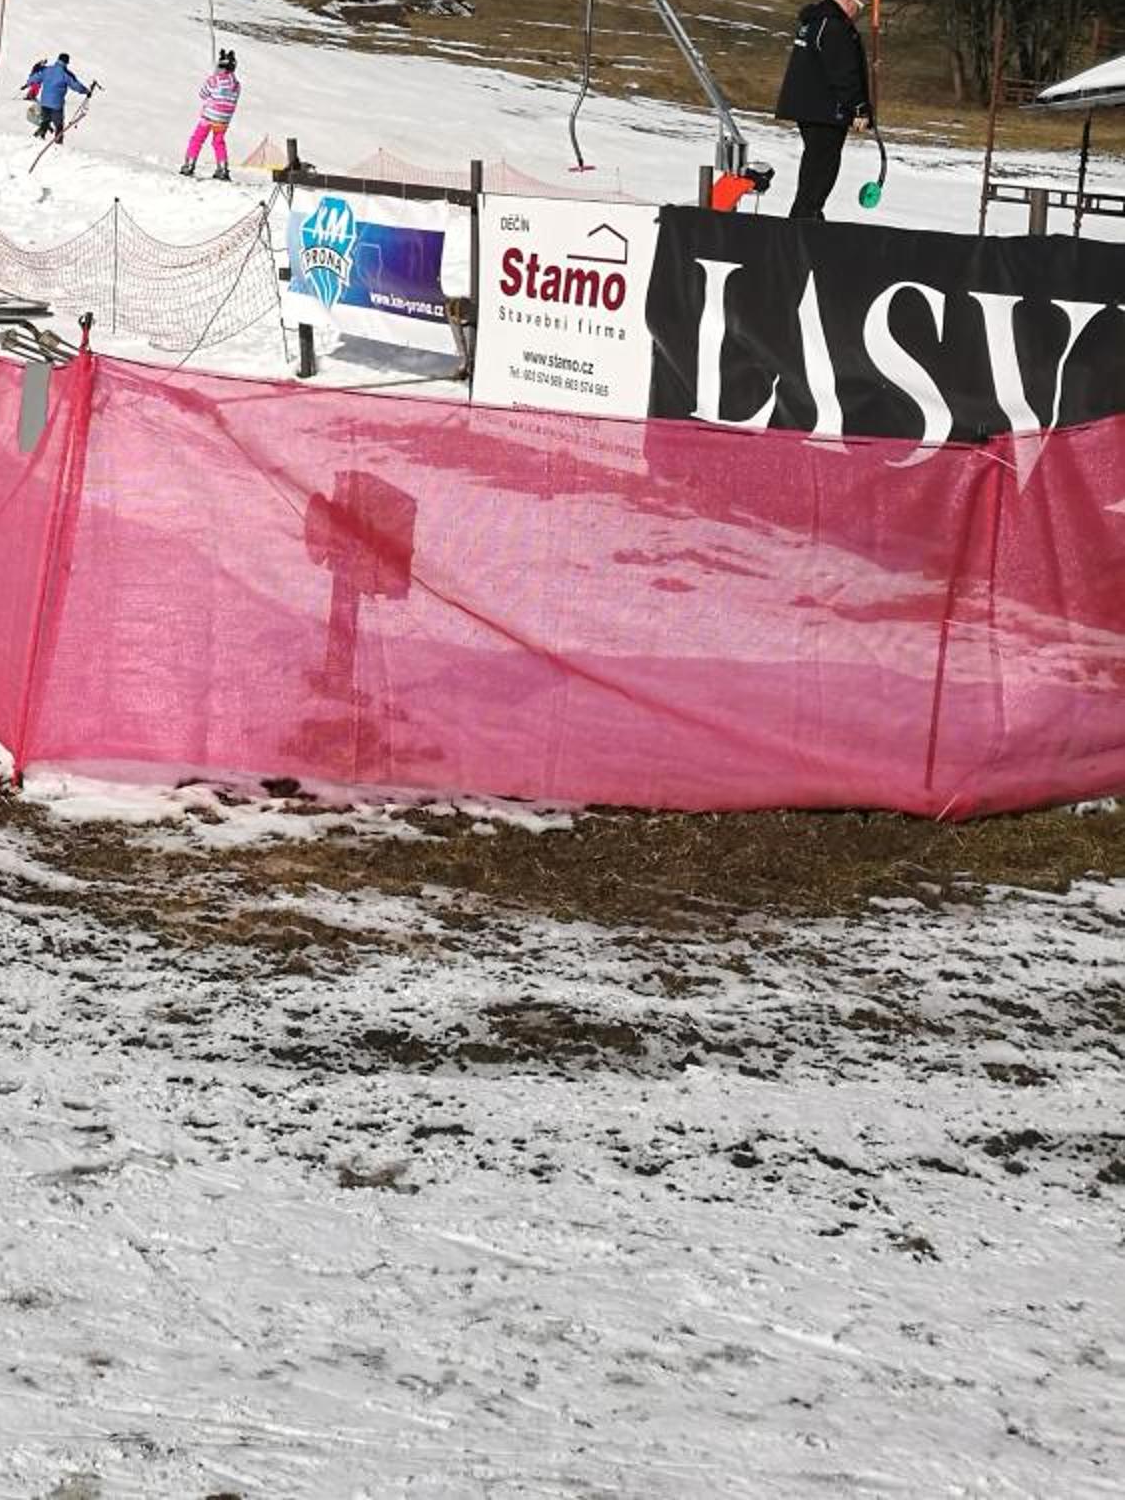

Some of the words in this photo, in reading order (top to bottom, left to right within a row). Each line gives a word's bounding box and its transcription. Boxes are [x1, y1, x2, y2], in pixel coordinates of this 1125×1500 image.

[304, 250, 344, 274] PRONA
[499, 247, 627, 311] Stamo
[578, 318, 627, 340] firma
[523, 351, 595, 375] www.stamo.cz
[689, 257, 1125, 510] LASV
